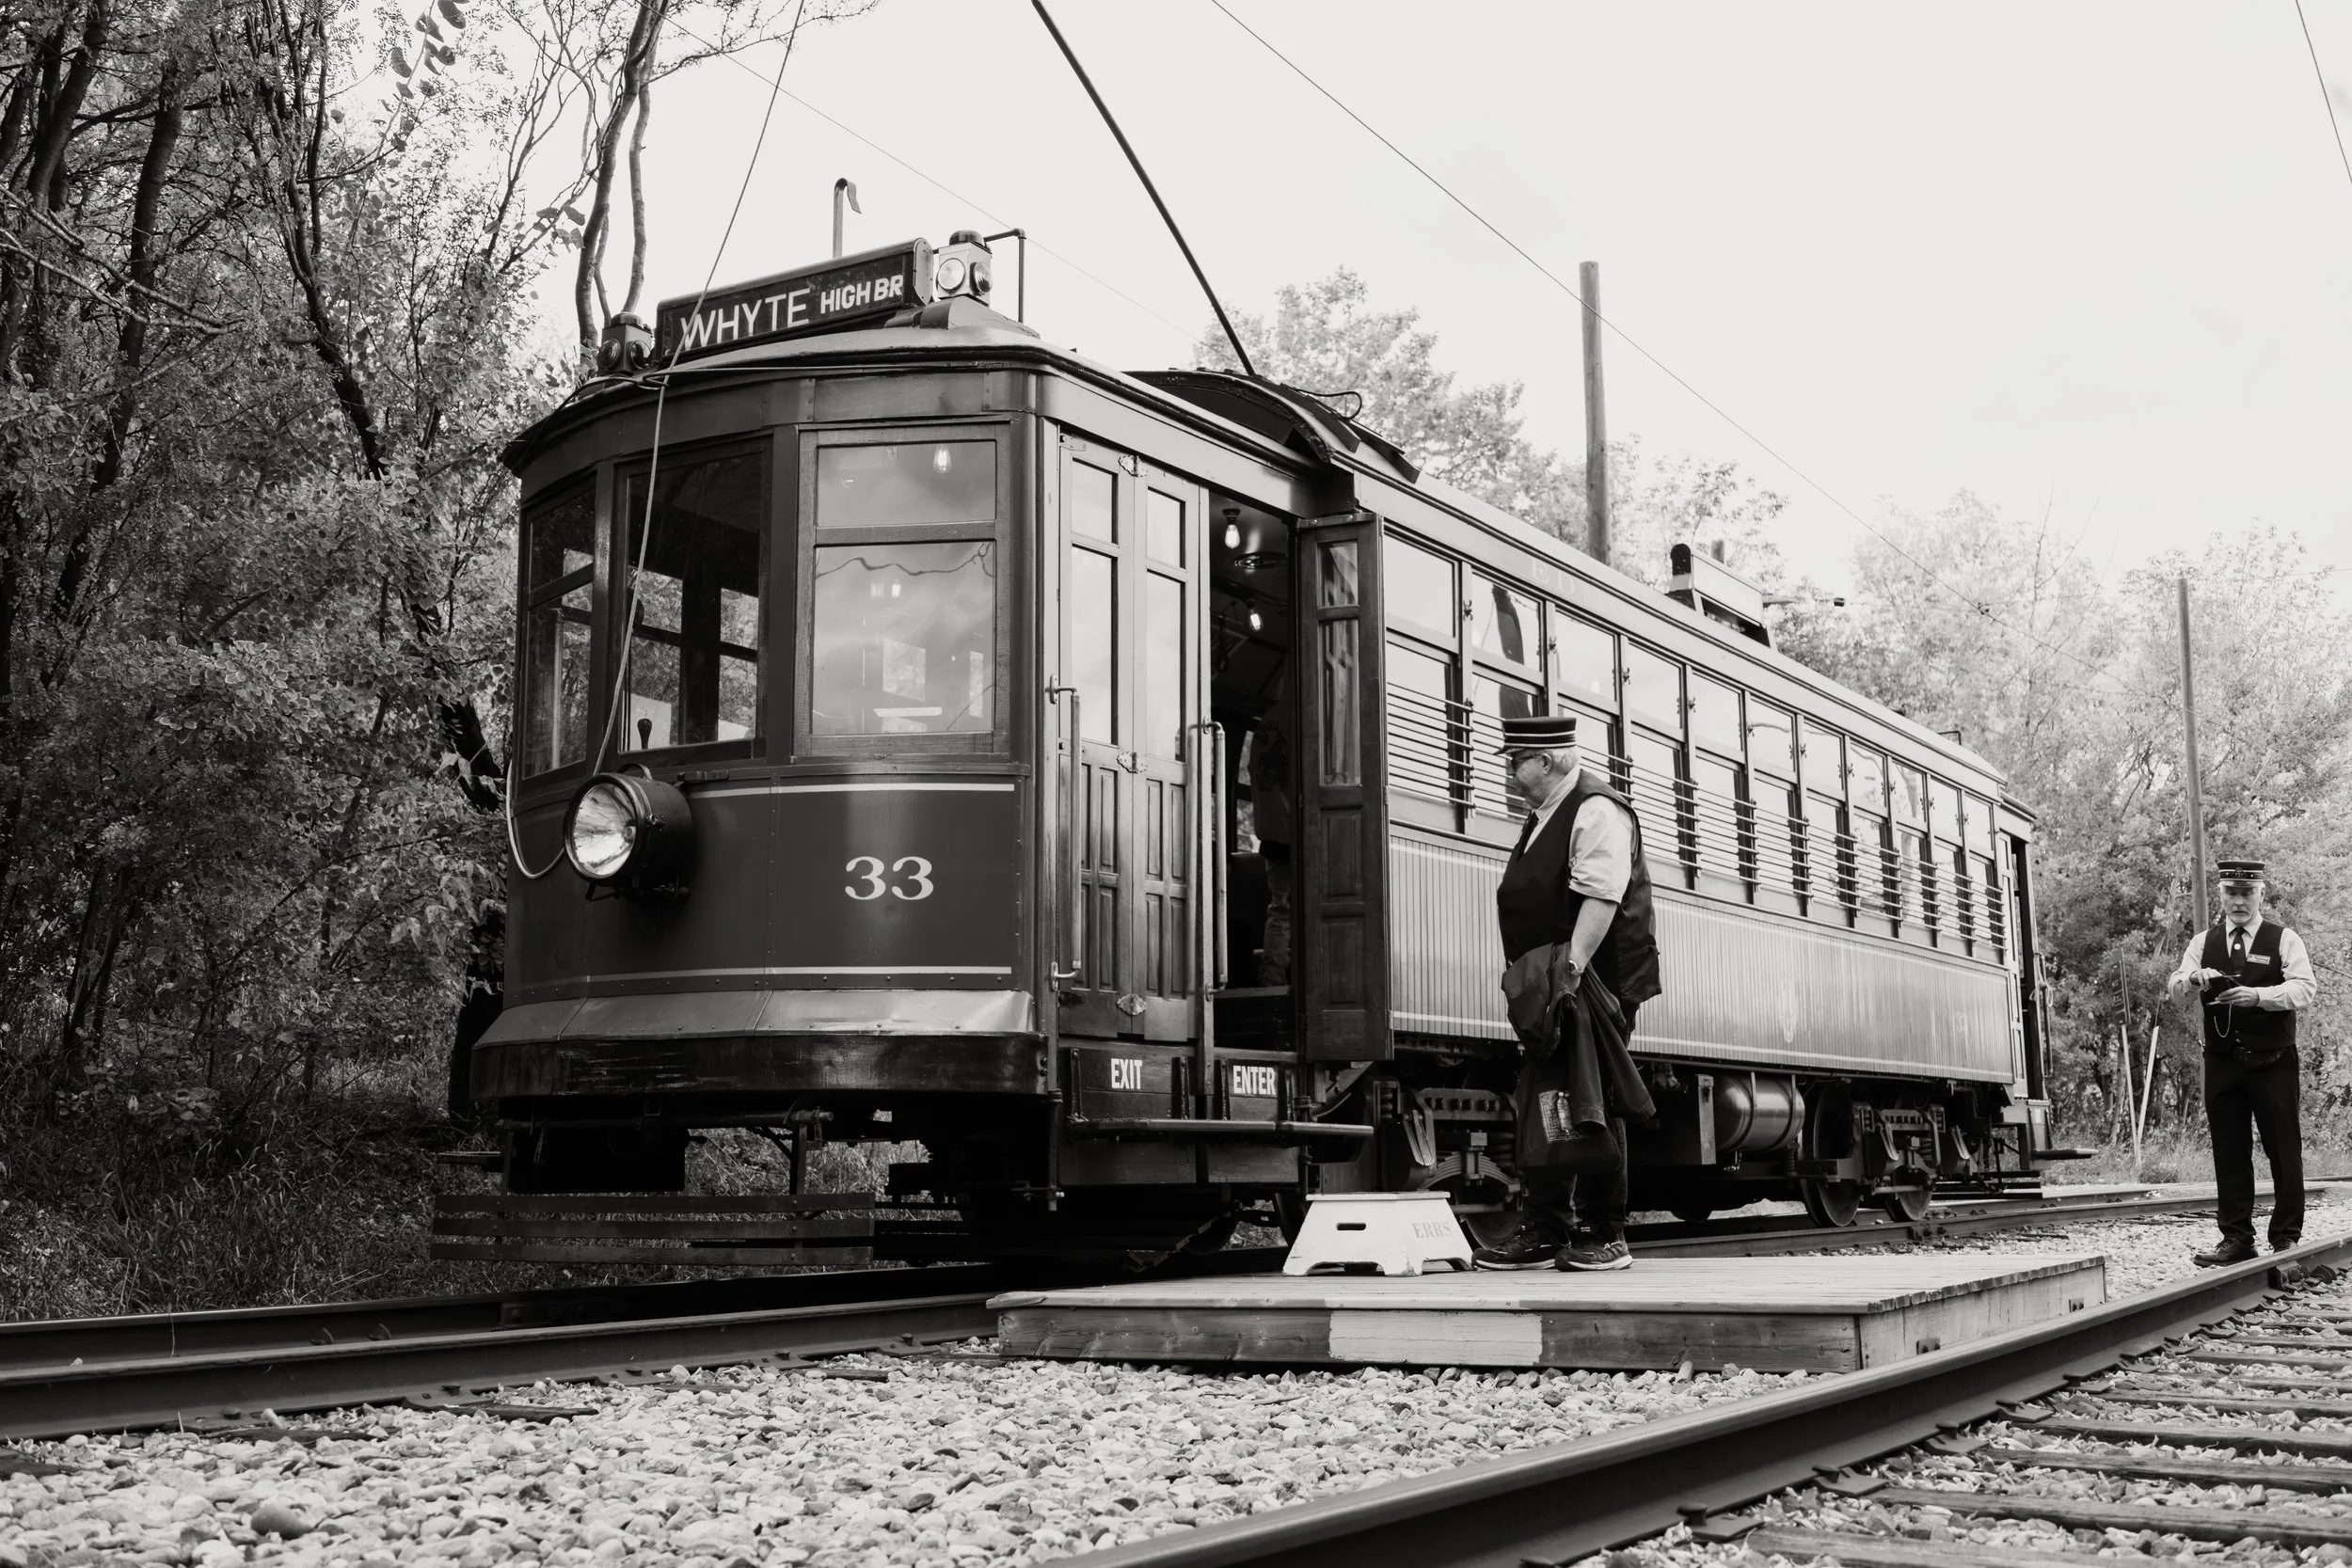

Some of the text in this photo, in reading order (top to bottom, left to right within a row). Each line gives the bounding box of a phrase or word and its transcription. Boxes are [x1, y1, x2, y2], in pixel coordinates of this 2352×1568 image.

[680, 274, 903, 351] WHYTE HIGH BR
[845, 856, 934, 900] 33
[1110, 1057, 1143, 1090] EXIT
[1232, 1065, 1276, 1096] ENTER
[1411, 1221, 1453, 1239] ERRS
